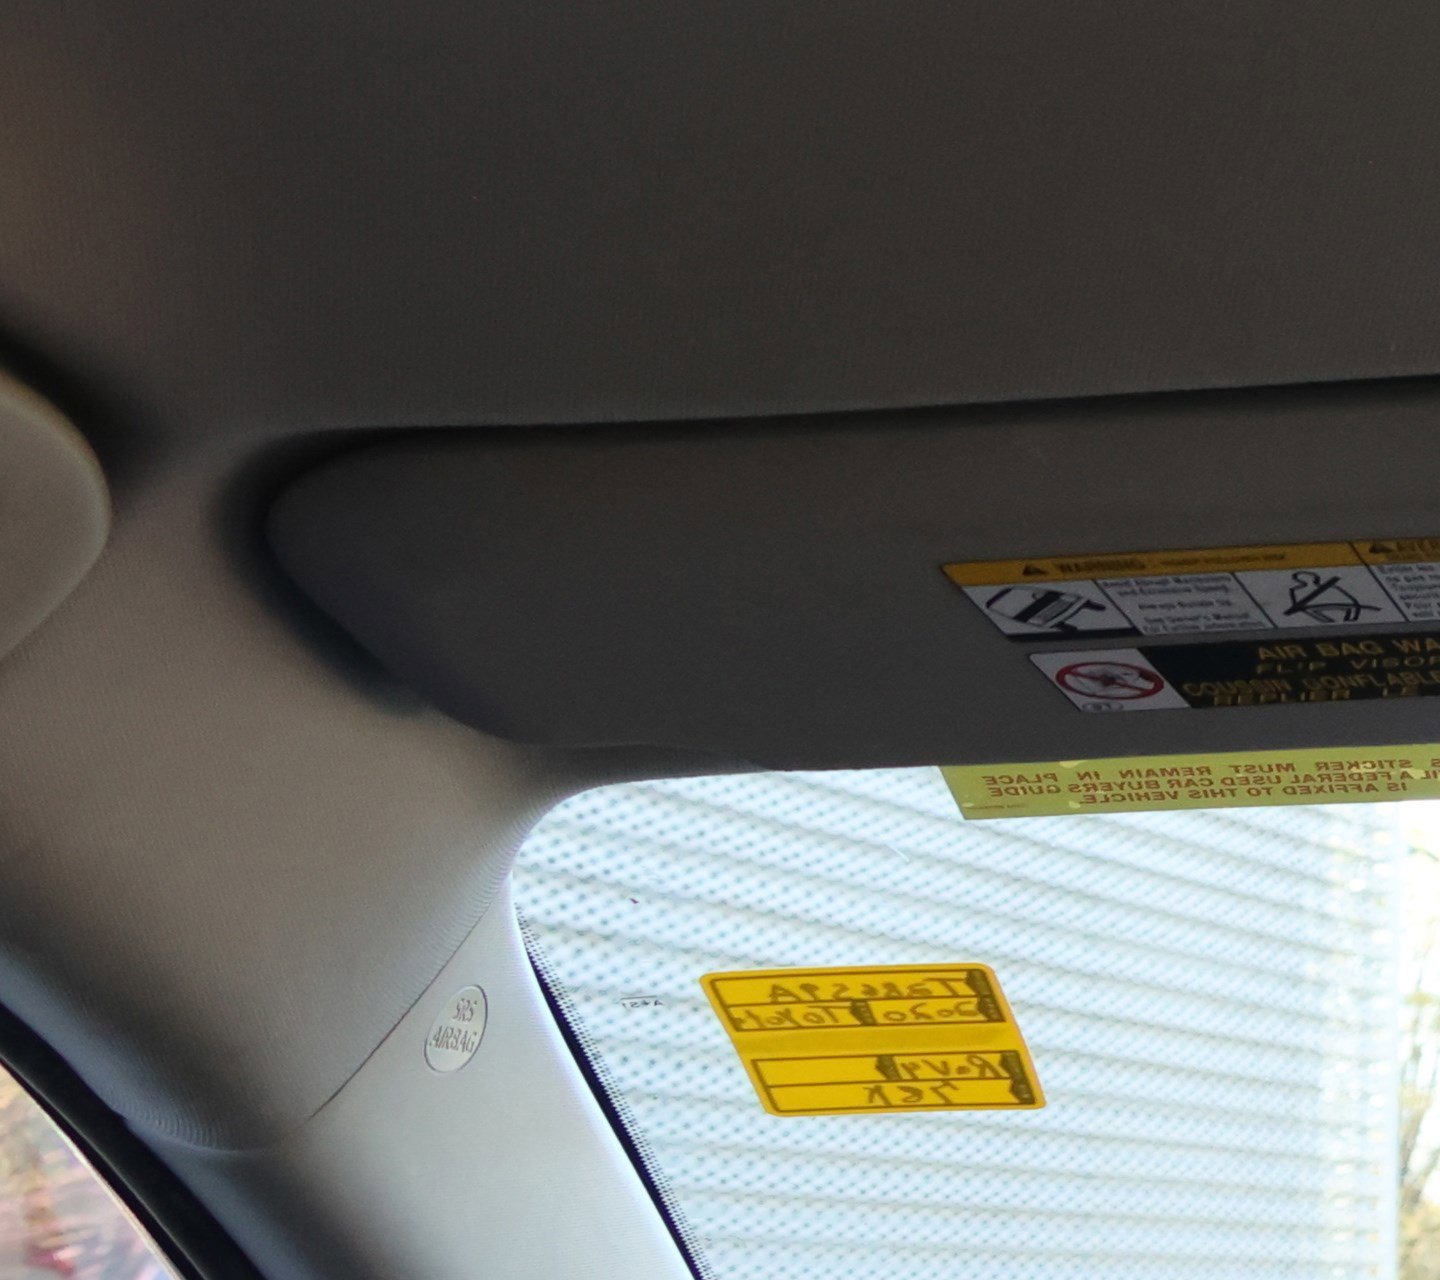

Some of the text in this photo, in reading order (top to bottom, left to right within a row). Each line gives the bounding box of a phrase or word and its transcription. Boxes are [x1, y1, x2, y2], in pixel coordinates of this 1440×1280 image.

[1258, 643, 1308, 660] AIR
[1315, 640, 1385, 658] BAG
[1182, 678, 1293, 697] COUSSIN
